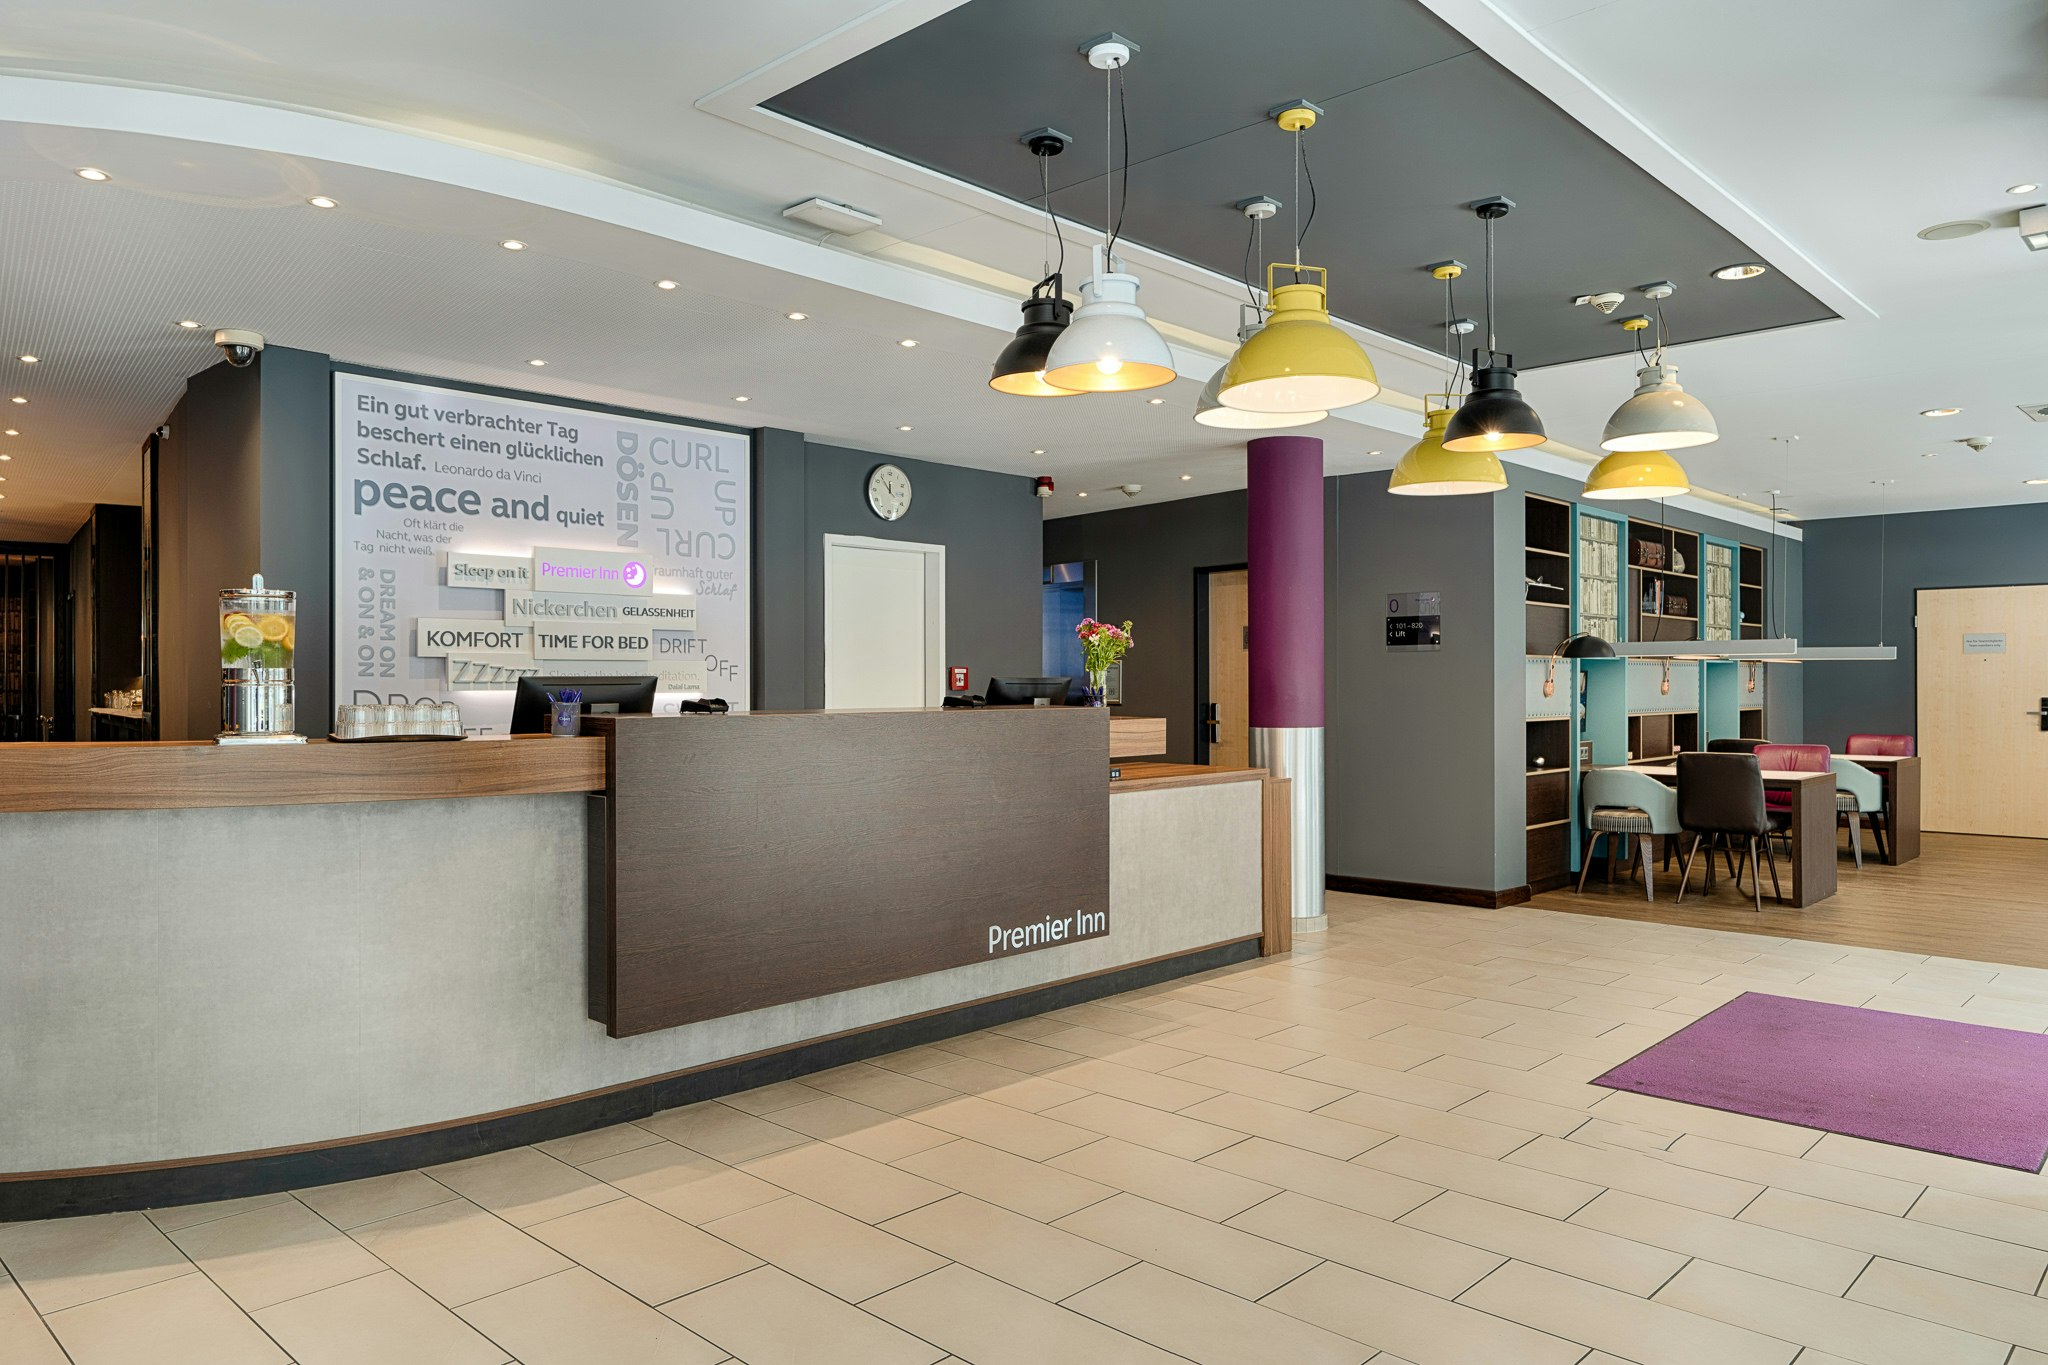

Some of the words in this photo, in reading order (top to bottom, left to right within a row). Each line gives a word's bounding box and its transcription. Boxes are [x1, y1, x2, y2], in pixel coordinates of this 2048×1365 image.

[357, 394, 389, 414] Ein
[394, 403, 429, 421] gut
[434, 409, 543, 435] verbrachter
[547, 421, 578, 443] Tag
[357, 420, 445, 448] beschert
[450, 434, 501, 454] einen
[506, 441, 604, 467] glücklichen
[649, 437, 730, 473] CURL
[357, 447, 426, 471] Schlaf.
[434, 461, 493, 478] Leonardo
[496, 468, 511, 480] da
[514, 469, 542, 483] Vinci
[354, 478, 482, 515] peace
[491, 494, 549, 521] and
[556, 508, 605, 528] quiet
[616, 431, 645, 548] DÖSEN
[650, 472, 674, 520] UP
[714, 480, 737, 526] UP
[376, 529, 411, 542] Nacht,
[413, 534, 434, 542] was
[436, 534, 453, 544] der
[403, 518, 421, 529] Oft
[423, 519, 447, 531] klärt
[449, 522, 464, 532] die
[353, 541, 374, 553] Tag
[379, 542, 406, 554] nicht
[656, 528, 736, 560] CURL
[454, 563, 494, 580] Sleep
[497, 568, 515, 579] on
[518, 566, 529, 579] it
[541, 561, 597, 580] Premier
[599, 565, 619, 581] Inn
[652, 566, 704, 579] raumhaft
[706, 570, 734, 582] guter
[357, 586, 375, 619] ON
[379, 569, 396, 641] DREAM
[696, 580, 738, 600] Schlaf
[1390, 599, 1399, 613] 0
[512, 597, 618, 618] Nickerchen
[622, 606, 696, 618] GELASSENHEIT
[427, 630, 524, 648] KOMFORT
[538, 634, 579, 649] TIME
[582, 635, 614, 649] FOR
[618, 636, 649, 650] BED
[660, 638, 708, 654] DRIFT
[357, 644, 375, 677] ON
[379, 645, 396, 678] ON
[704, 654, 739, 682] OFF
[988, 914, 1073, 954] Premier
[1077, 909, 1106, 936] Inn
